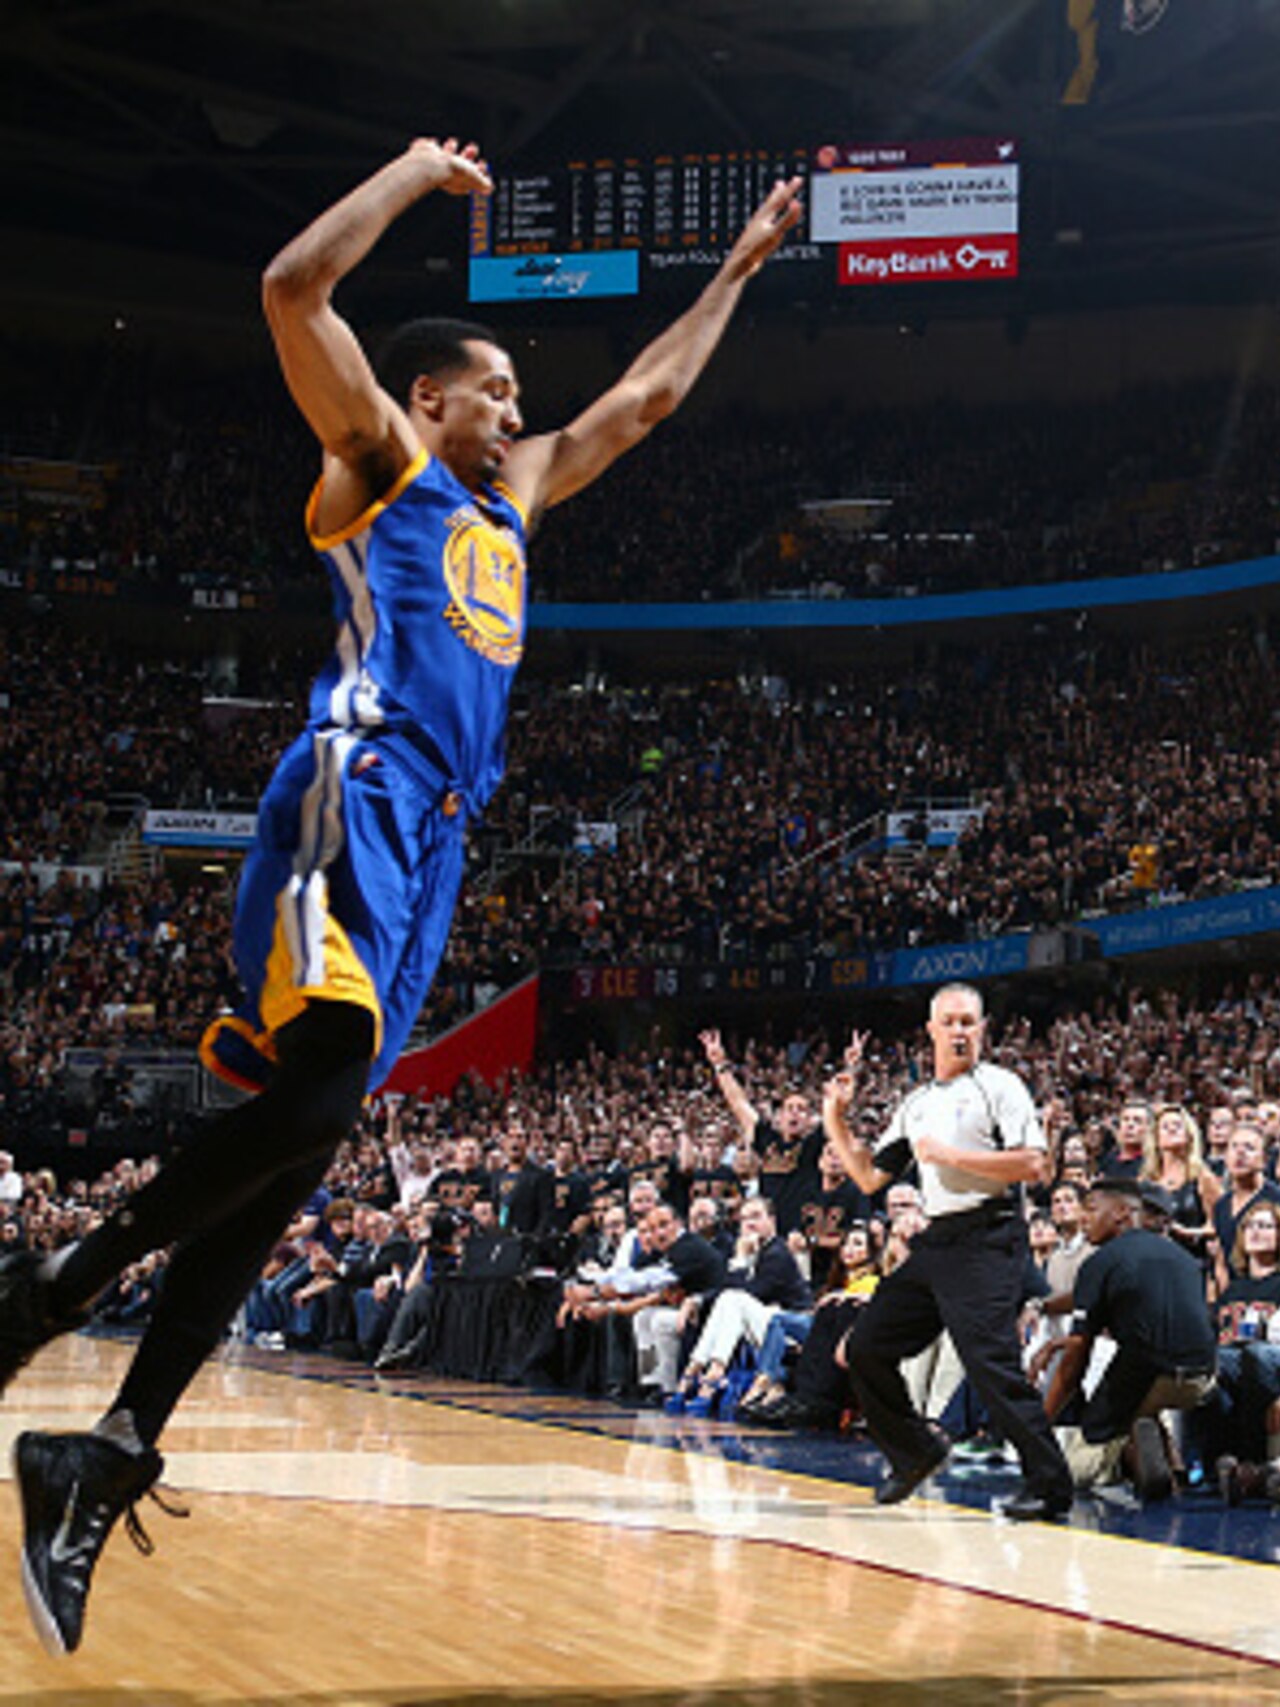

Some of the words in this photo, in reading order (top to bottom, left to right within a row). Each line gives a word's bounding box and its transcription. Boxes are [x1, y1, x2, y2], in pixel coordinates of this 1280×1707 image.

[848, 251, 952, 278] KeyBank
[911, 946, 988, 979] AXON
[601, 967, 639, 997] CLE
